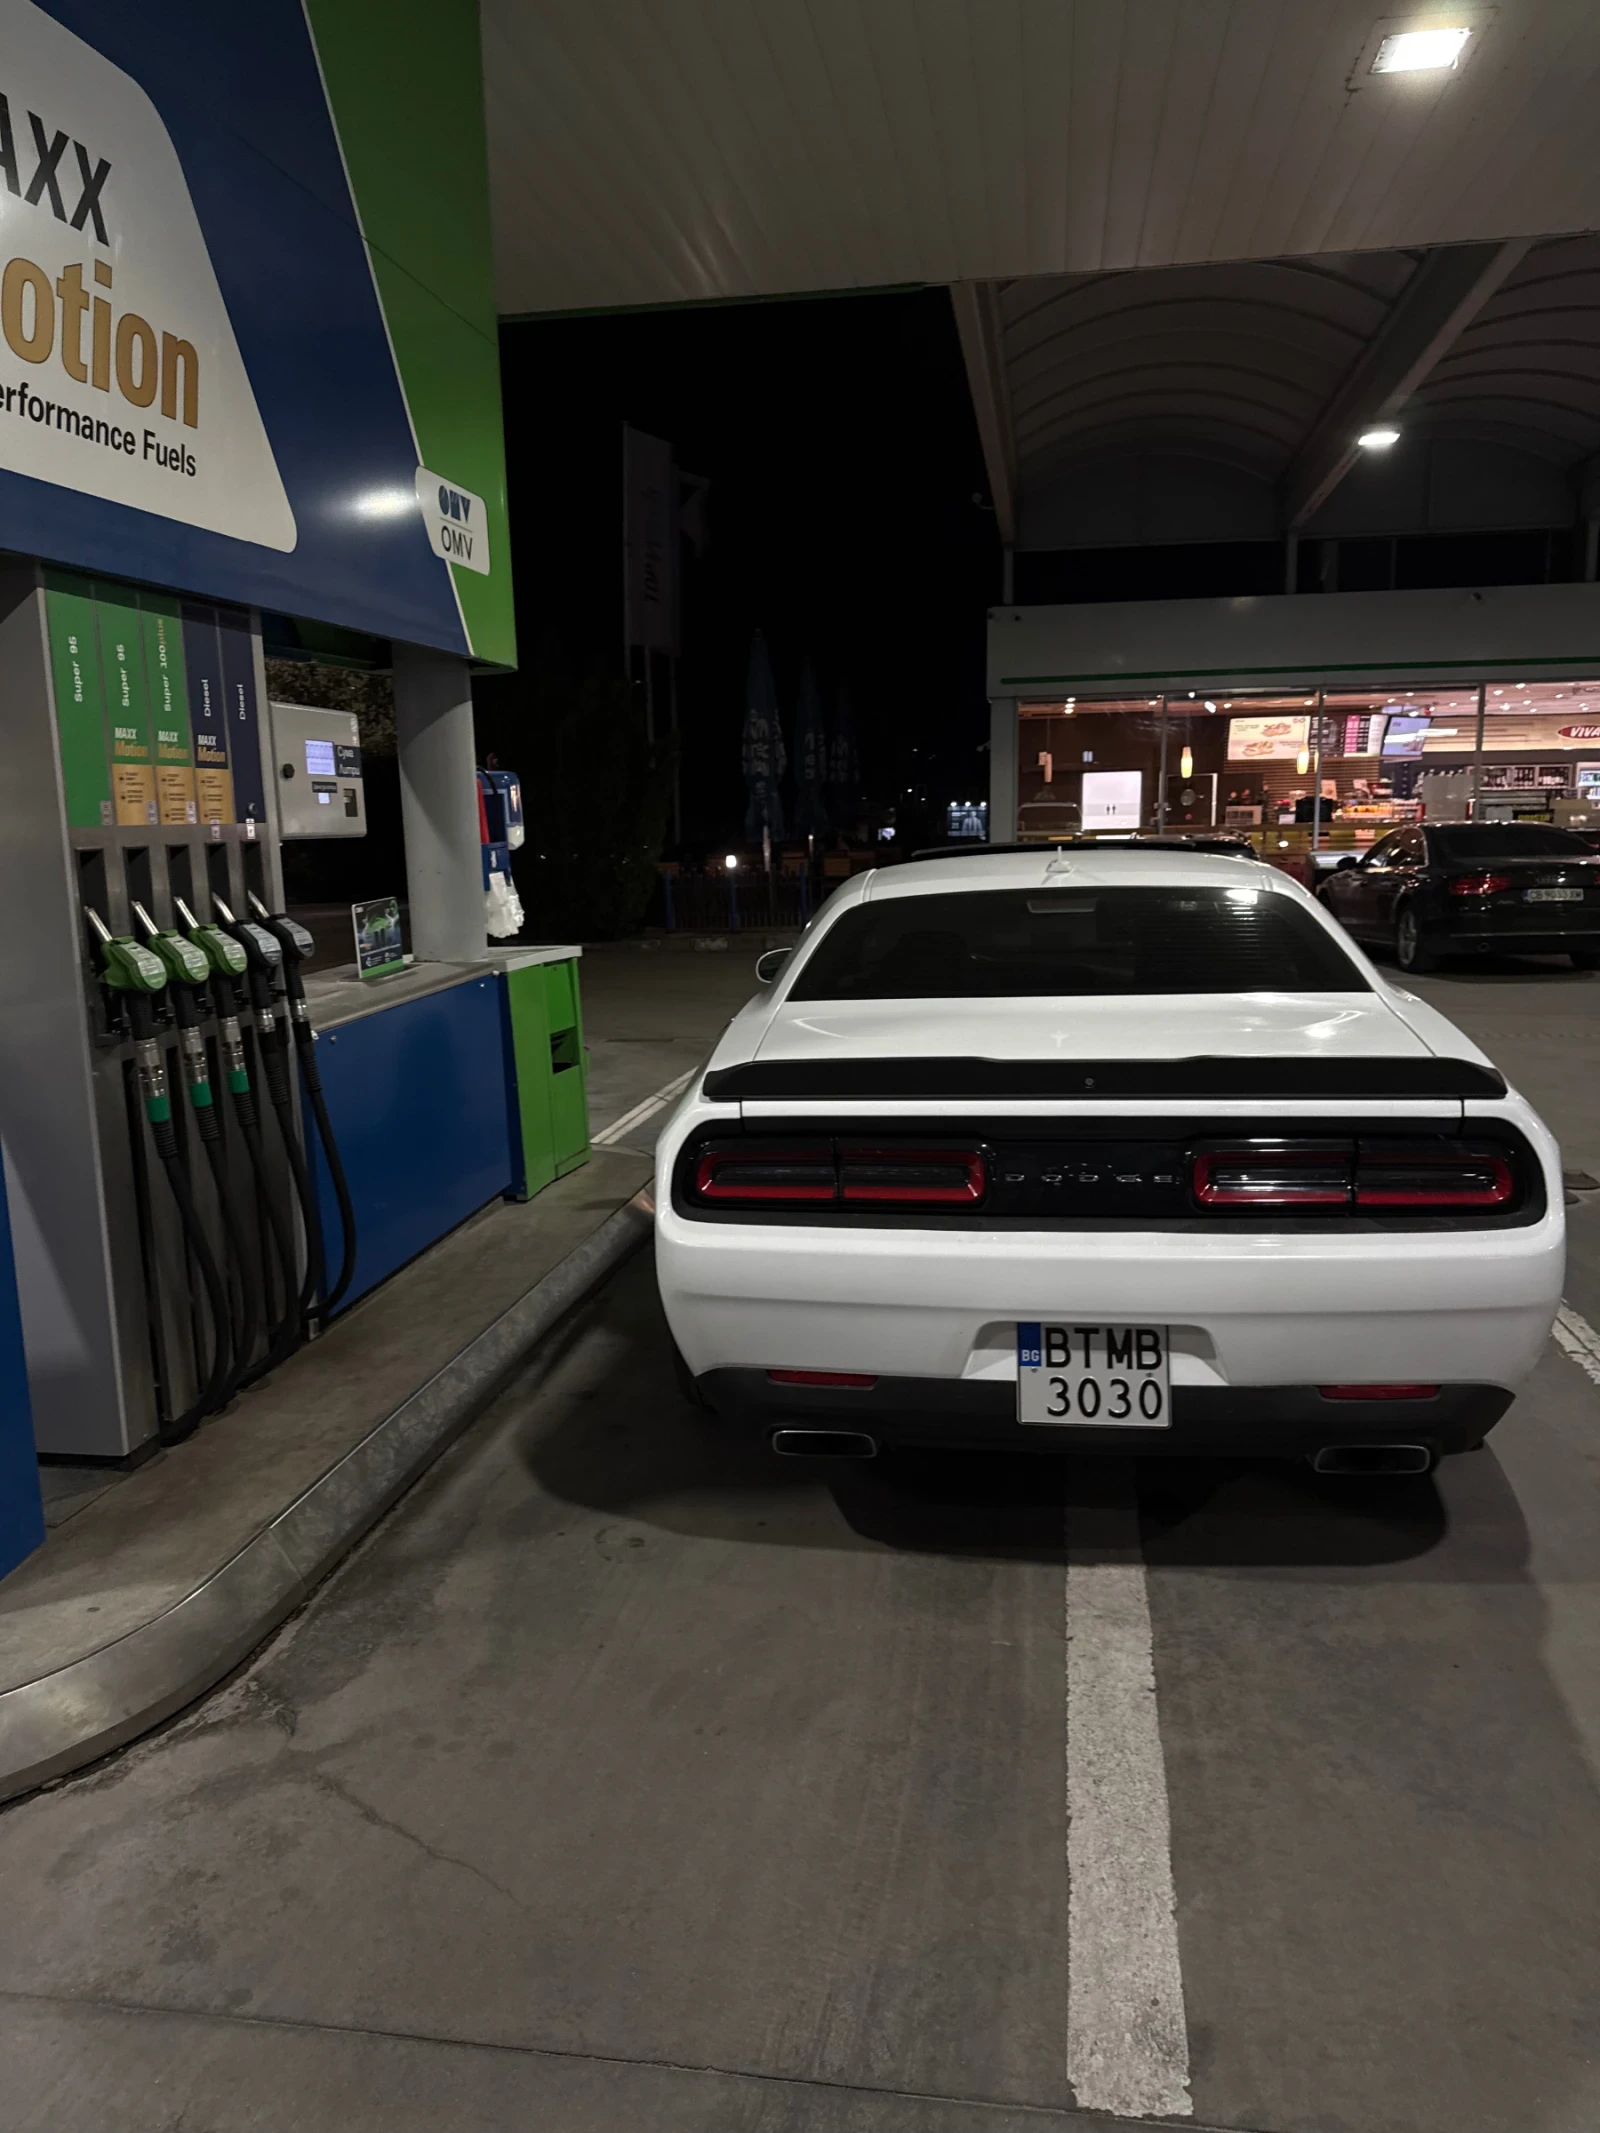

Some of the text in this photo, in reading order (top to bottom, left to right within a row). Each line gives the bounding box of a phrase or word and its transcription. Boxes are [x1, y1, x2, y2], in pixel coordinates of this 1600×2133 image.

[0, 381, 197, 477] rformance Fuels
[441, 525, 473, 560] OMV
[72, 660, 83, 702] Super
[120, 667, 130, 707] Super
[162, 674, 172, 712] Super
[201, 679, 211, 717] Diesel
[236, 684, 246, 720] Diesel
[115, 727, 137, 740] MAXX
[115, 740, 147, 757] Motion
[157, 730, 179, 742] MAXX
[197, 734, 217, 746] MAXX
[1021, 1350, 1040, 1361] BG
[1045, 1327, 1162, 1370] BTMB
[1047, 1376, 1162, 1420] 3030
